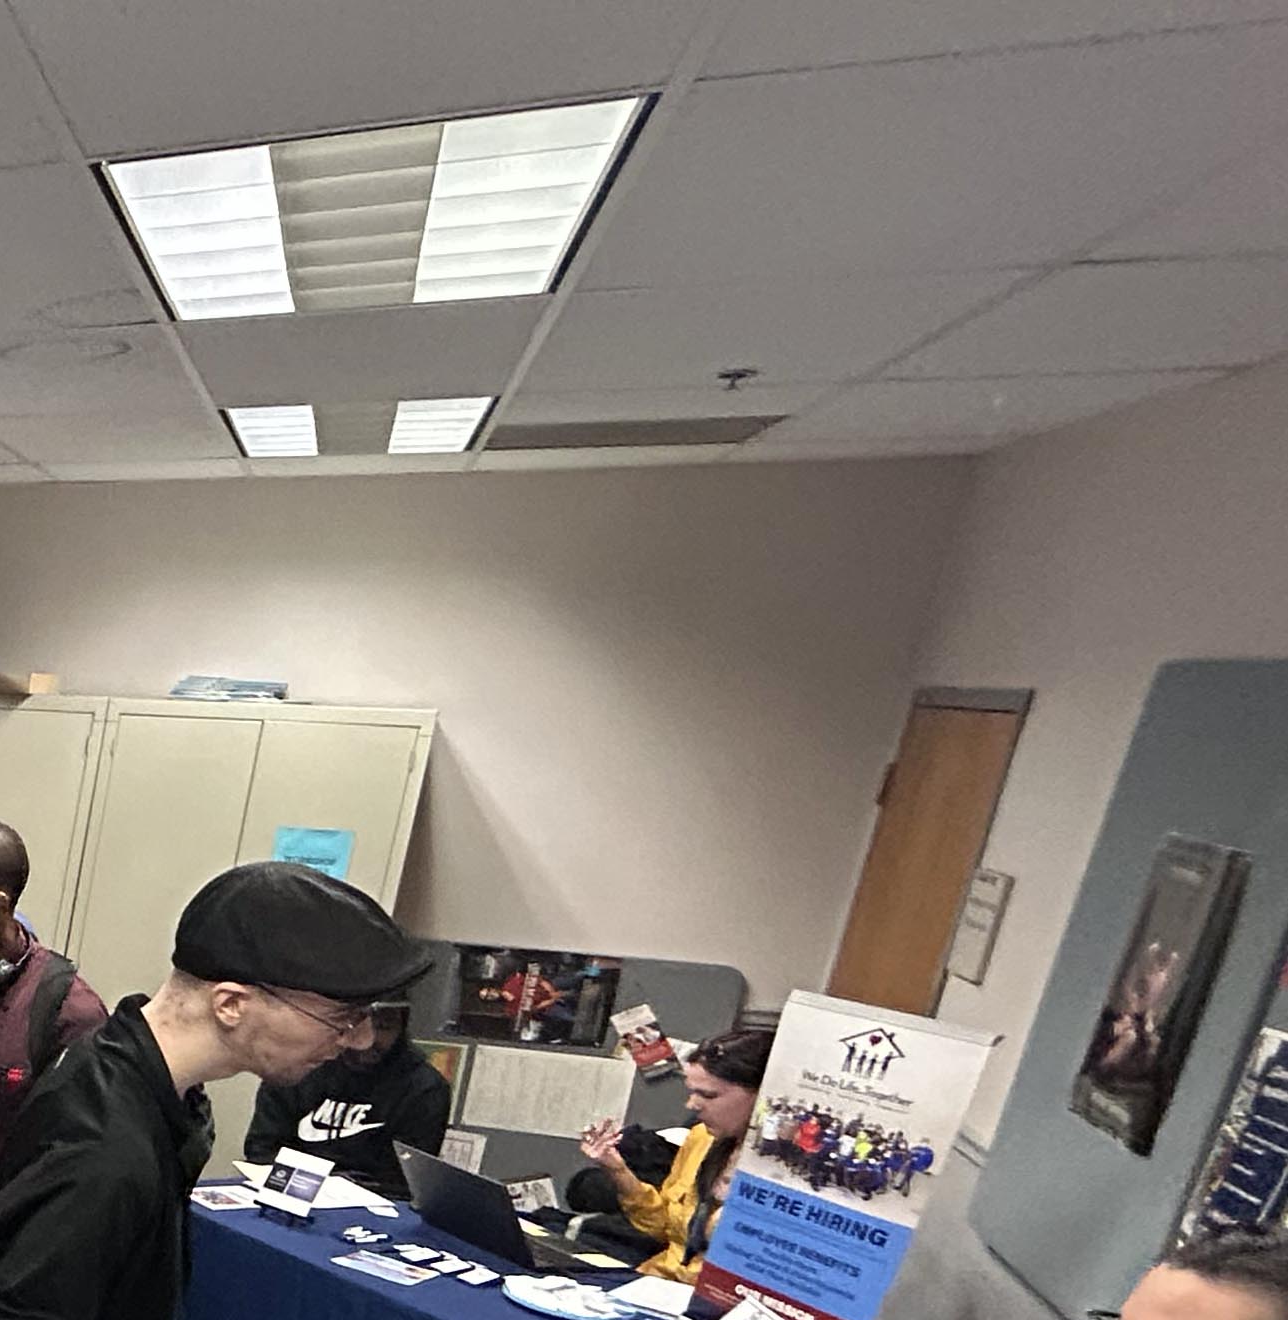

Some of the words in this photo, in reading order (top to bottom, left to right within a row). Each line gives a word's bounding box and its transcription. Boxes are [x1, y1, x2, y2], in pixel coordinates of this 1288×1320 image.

[312, 1098, 373, 1128] NIKE
[738, 1181, 804, 1218] WE'RE
[804, 1204, 890, 1248] HIRING
